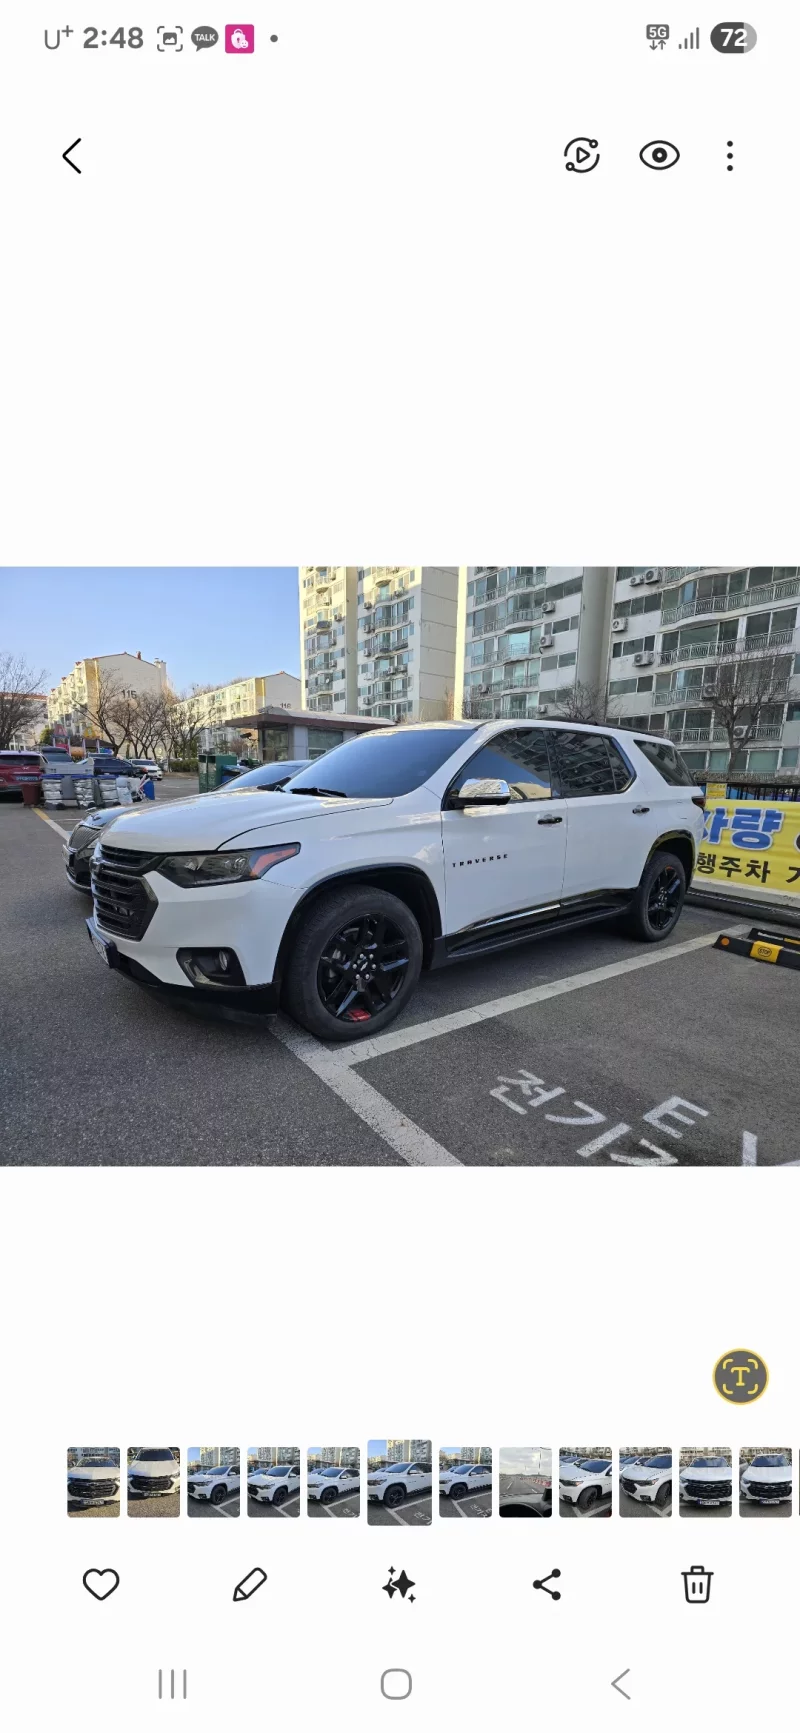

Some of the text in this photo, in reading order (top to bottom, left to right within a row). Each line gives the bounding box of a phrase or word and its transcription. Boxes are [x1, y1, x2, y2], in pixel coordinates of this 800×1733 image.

[83, 26, 144, 49] 2:48
[194, 33, 216, 42] TALK
[649, 26, 667, 38] 5G
[720, 28, 748, 47] 72
[121, 689, 137, 699] 115
[452, 853, 508, 868] TRAVERSE
